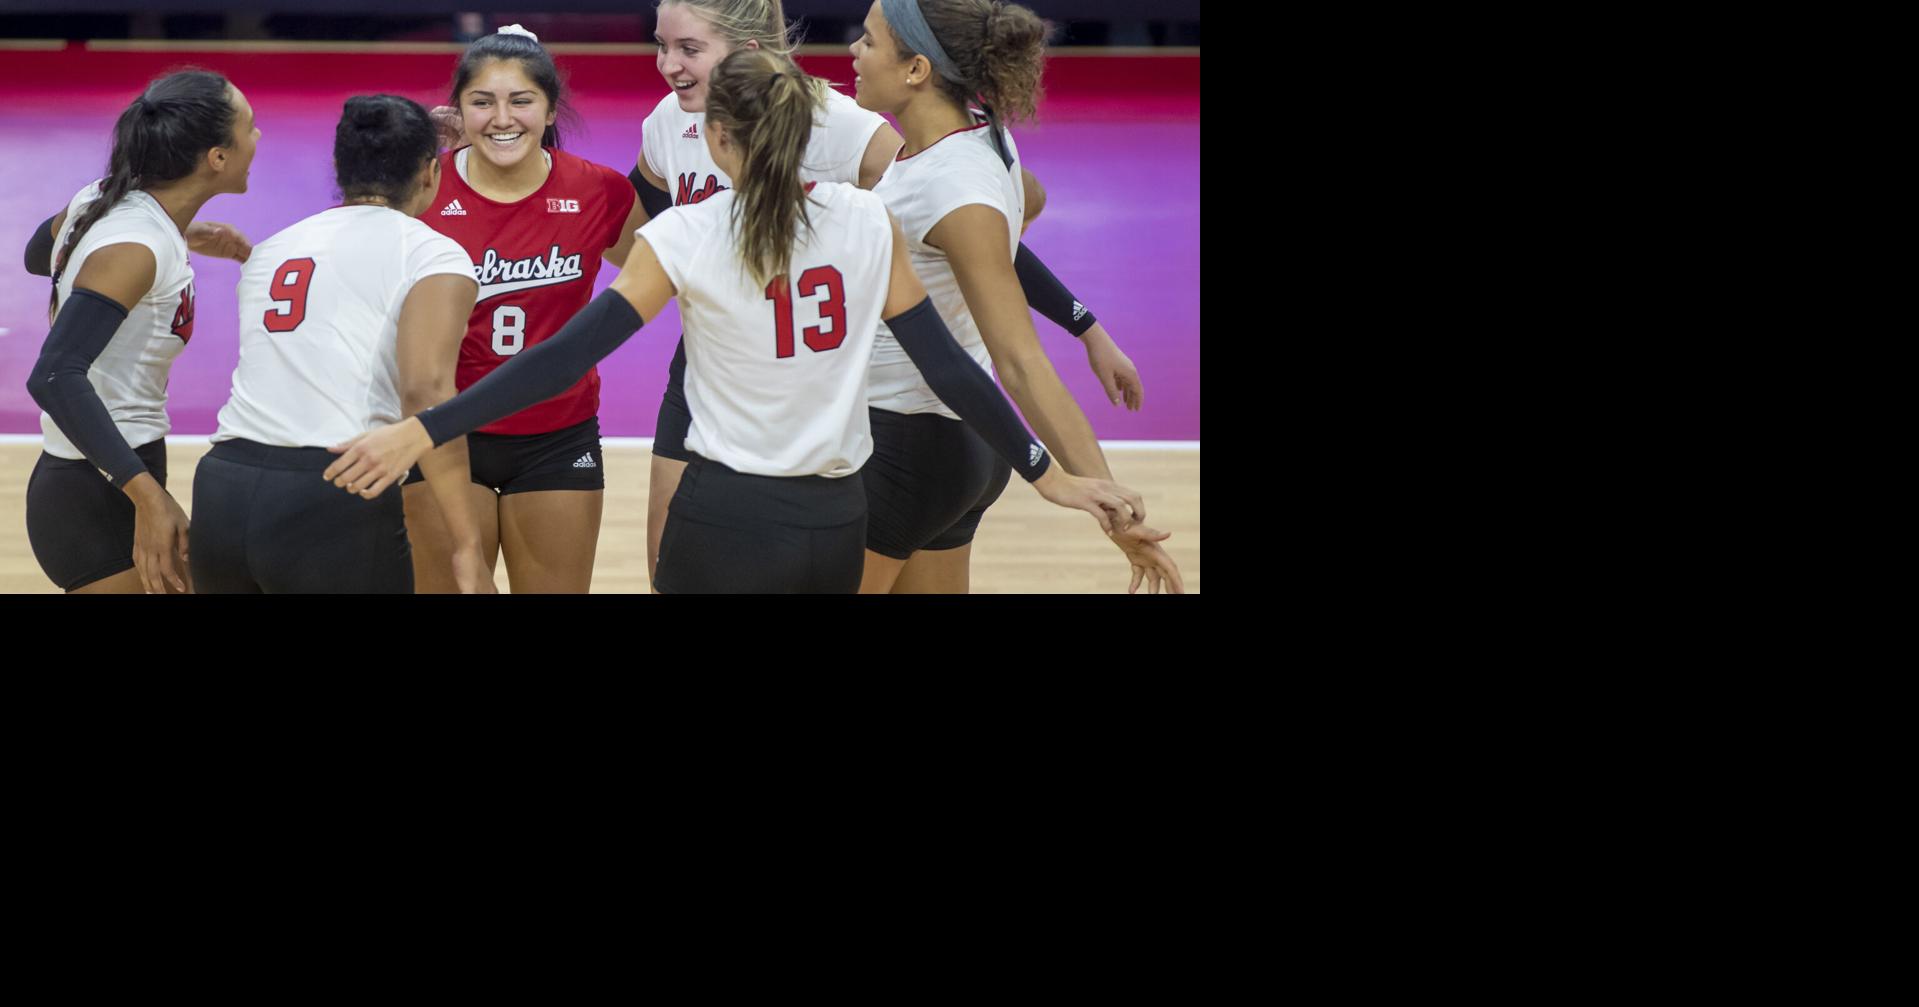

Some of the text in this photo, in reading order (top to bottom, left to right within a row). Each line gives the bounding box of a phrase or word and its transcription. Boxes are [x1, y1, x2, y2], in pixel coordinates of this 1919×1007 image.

[263, 256, 316, 333] 9
[473, 244, 583, 290] ebraska
[491, 304, 526, 356] 8
[765, 264, 847, 359] 13
